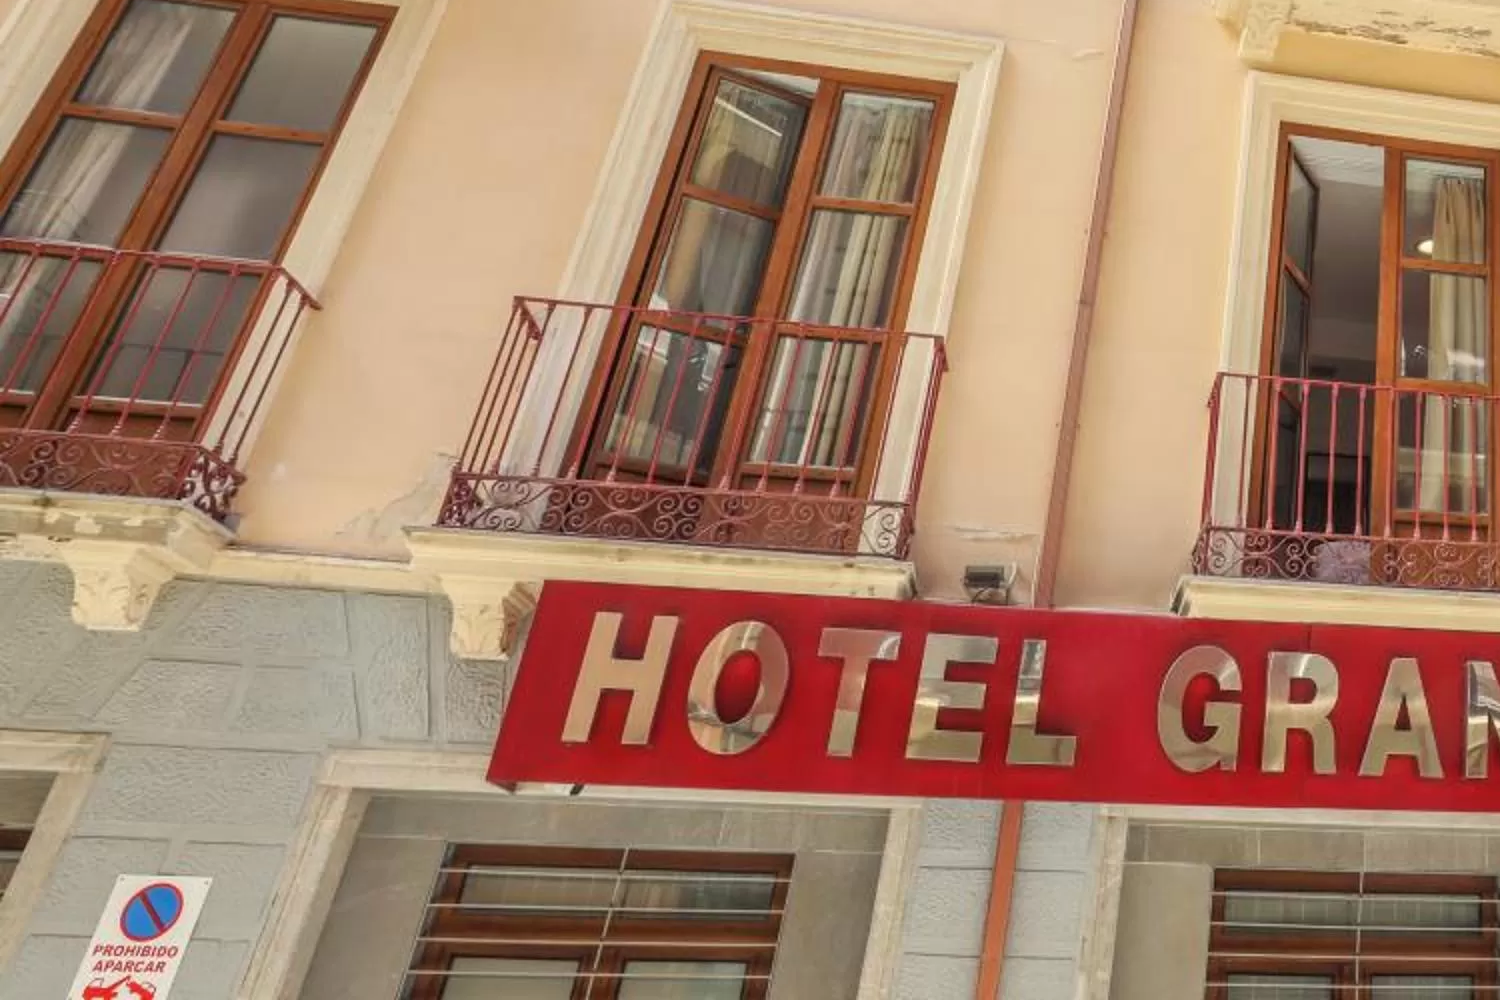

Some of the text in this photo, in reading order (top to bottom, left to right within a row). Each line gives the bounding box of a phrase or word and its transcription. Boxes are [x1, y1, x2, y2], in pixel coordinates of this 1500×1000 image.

[560, 610, 1077, 766] HOTEL
[92, 944, 179, 958] PROHIBIDO
[92, 960, 167, 973] APARCAR
